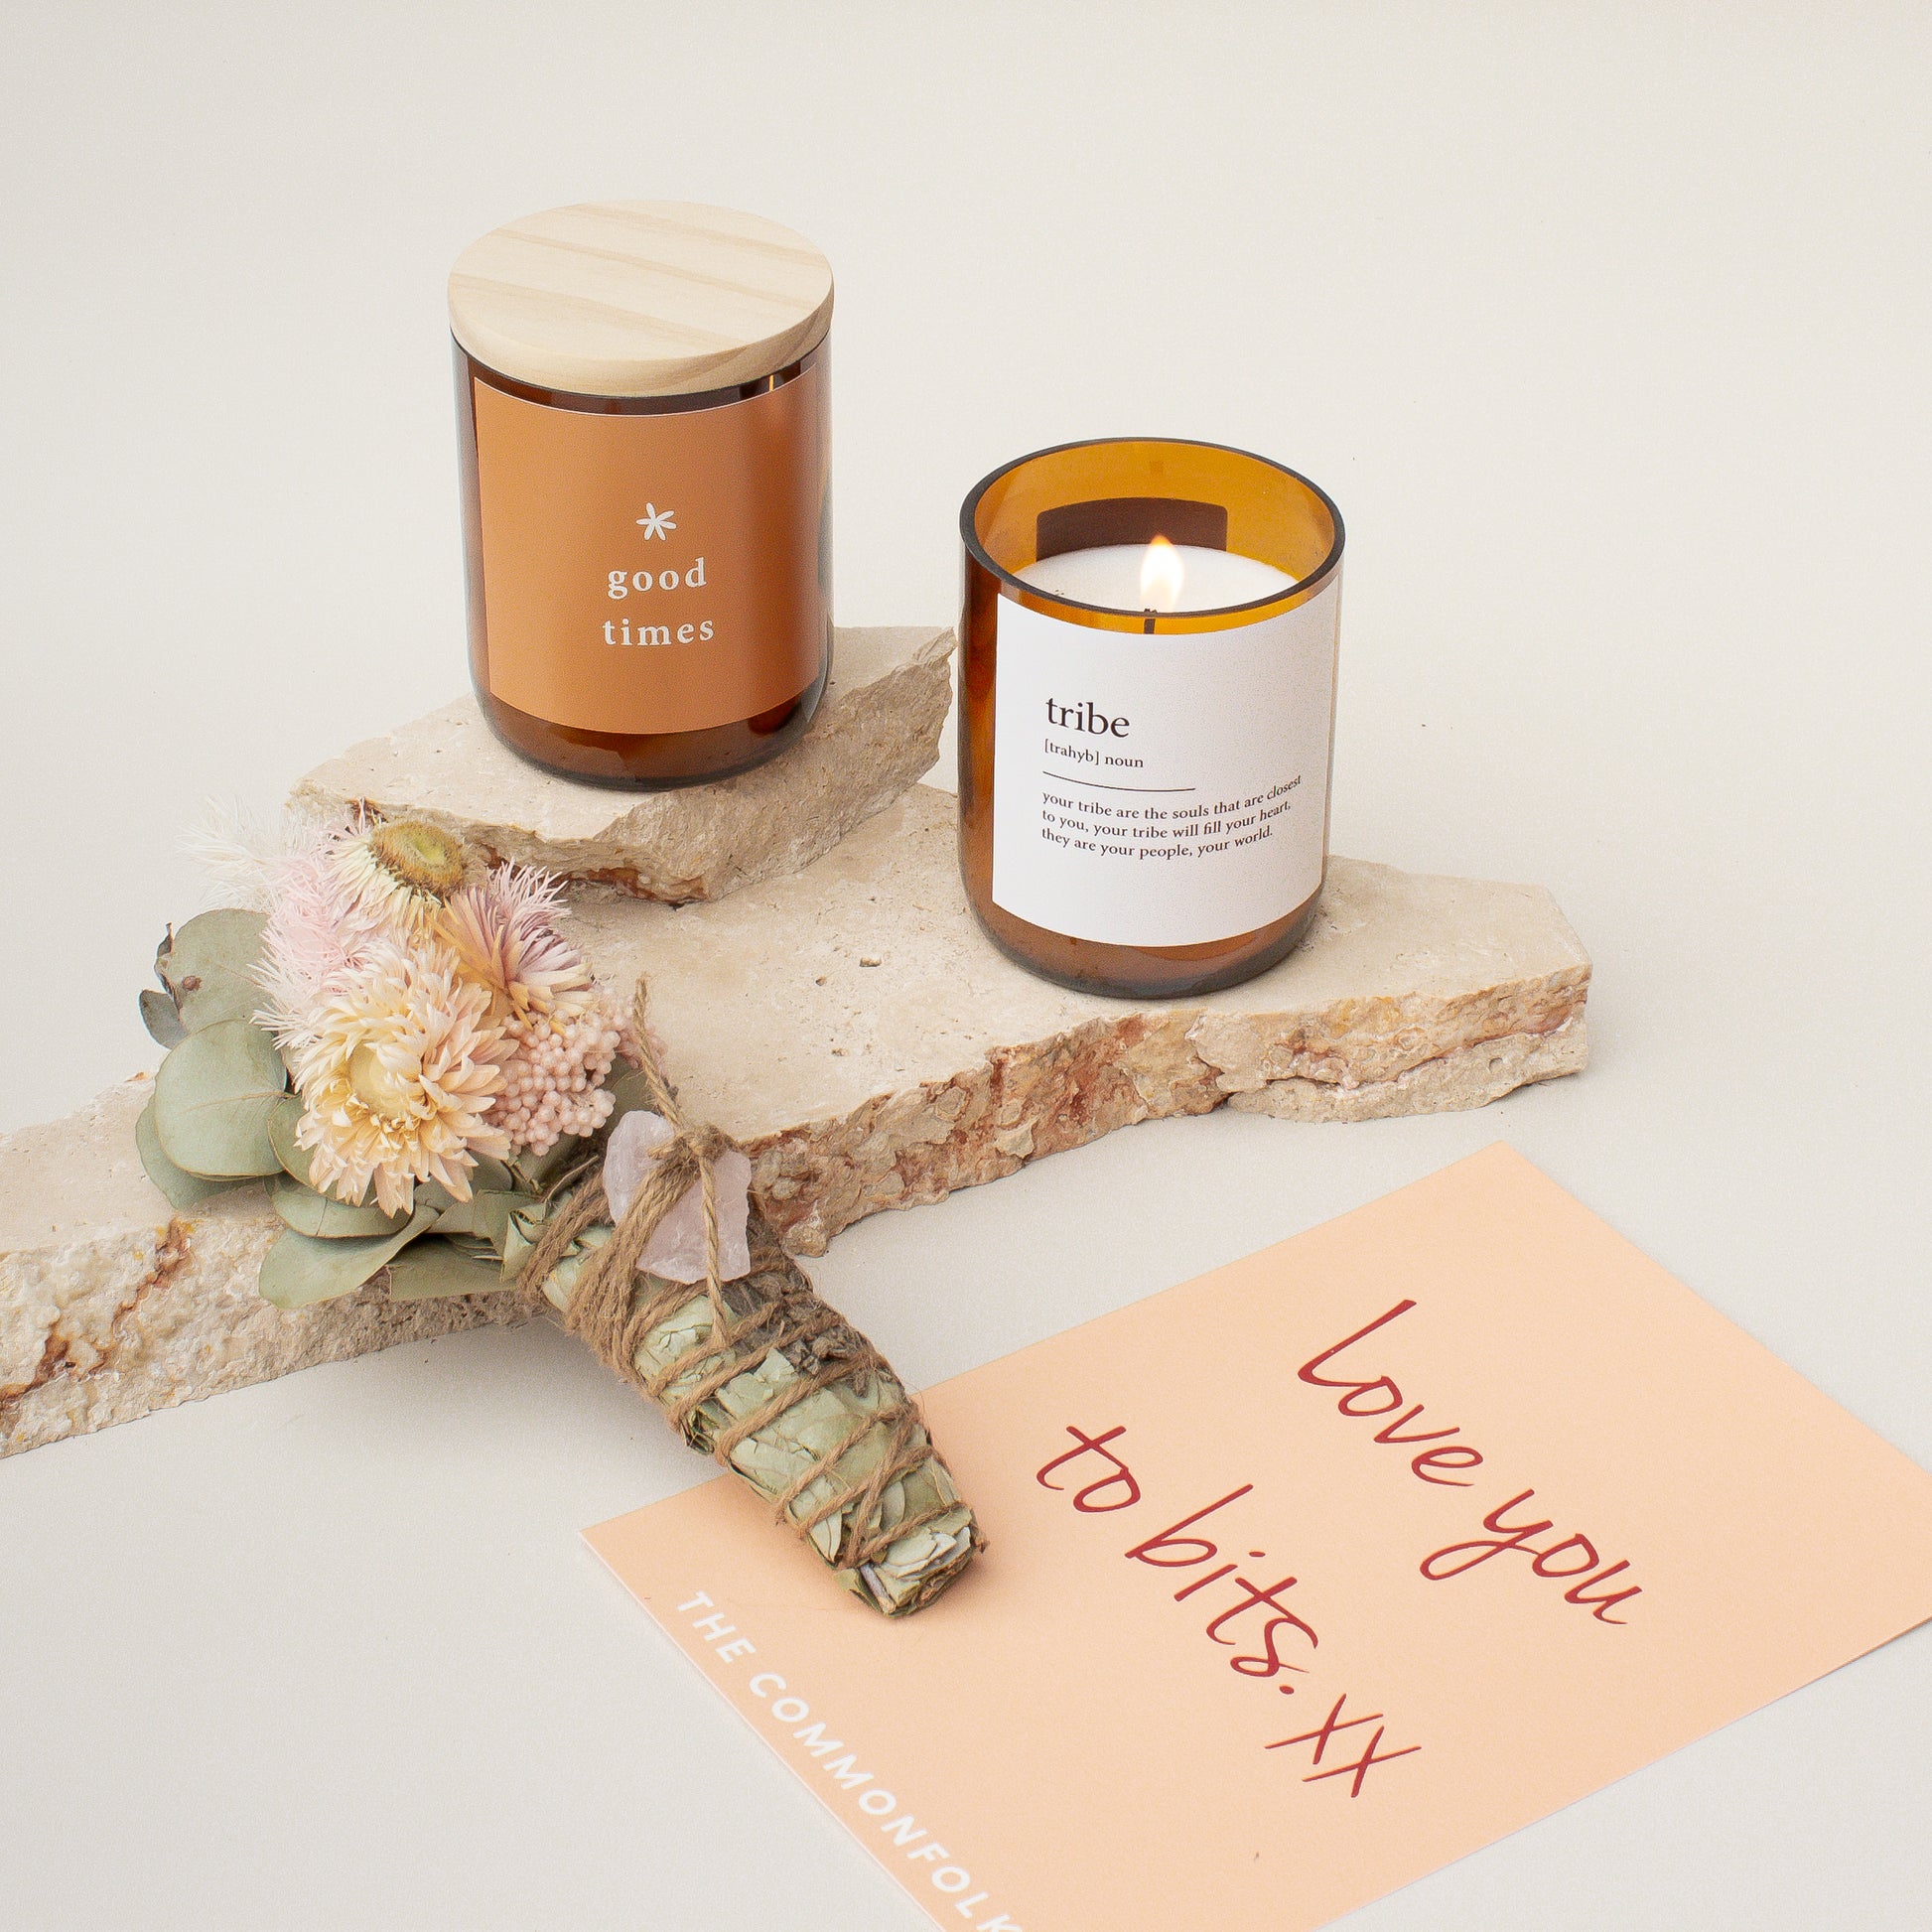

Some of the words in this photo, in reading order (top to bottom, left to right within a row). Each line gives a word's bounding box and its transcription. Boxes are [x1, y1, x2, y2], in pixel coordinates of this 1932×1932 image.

[608, 556, 707, 600] good
[602, 619, 714, 646] times
[1045, 697, 1130, 738] tribe
[1044, 739, 1099, 765] [trahyb]
[1104, 757, 1144, 768] noun
[1042, 791, 1073, 809] your
[1078, 801, 1112, 816] tribe
[1116, 808, 1139, 819] are
[1145, 807, 1168, 819] the
[1173, 804, 1209, 819] souls
[1213, 800, 1241, 815] that
[1244, 794, 1264, 808] are
[1266, 774, 1302, 800] closest
[1041, 810, 1055, 823] to
[1059, 817, 1089, 832] you,
[1093, 822, 1128, 839] your
[1133, 824, 1168, 838] tribe
[1173, 823, 1198, 838] will
[1203, 821, 1221, 835] fill
[1225, 815, 1257, 835] your
[1259, 801, 1291, 822] heart,
[1041, 828, 1070, 848] they
[1074, 839, 1096, 851] are
[1100, 842, 1135, 859] your
[1139, 844, 1193, 860] people,
[1197, 841, 1230, 858] your
[1234, 826, 1273, 847] world.
[1035, 1426, 1141, 1513] to
[1297, 1299, 1484, 1487] love
[1419, 1488, 1642, 1625] you
[676, 1589, 757, 1664] THE
